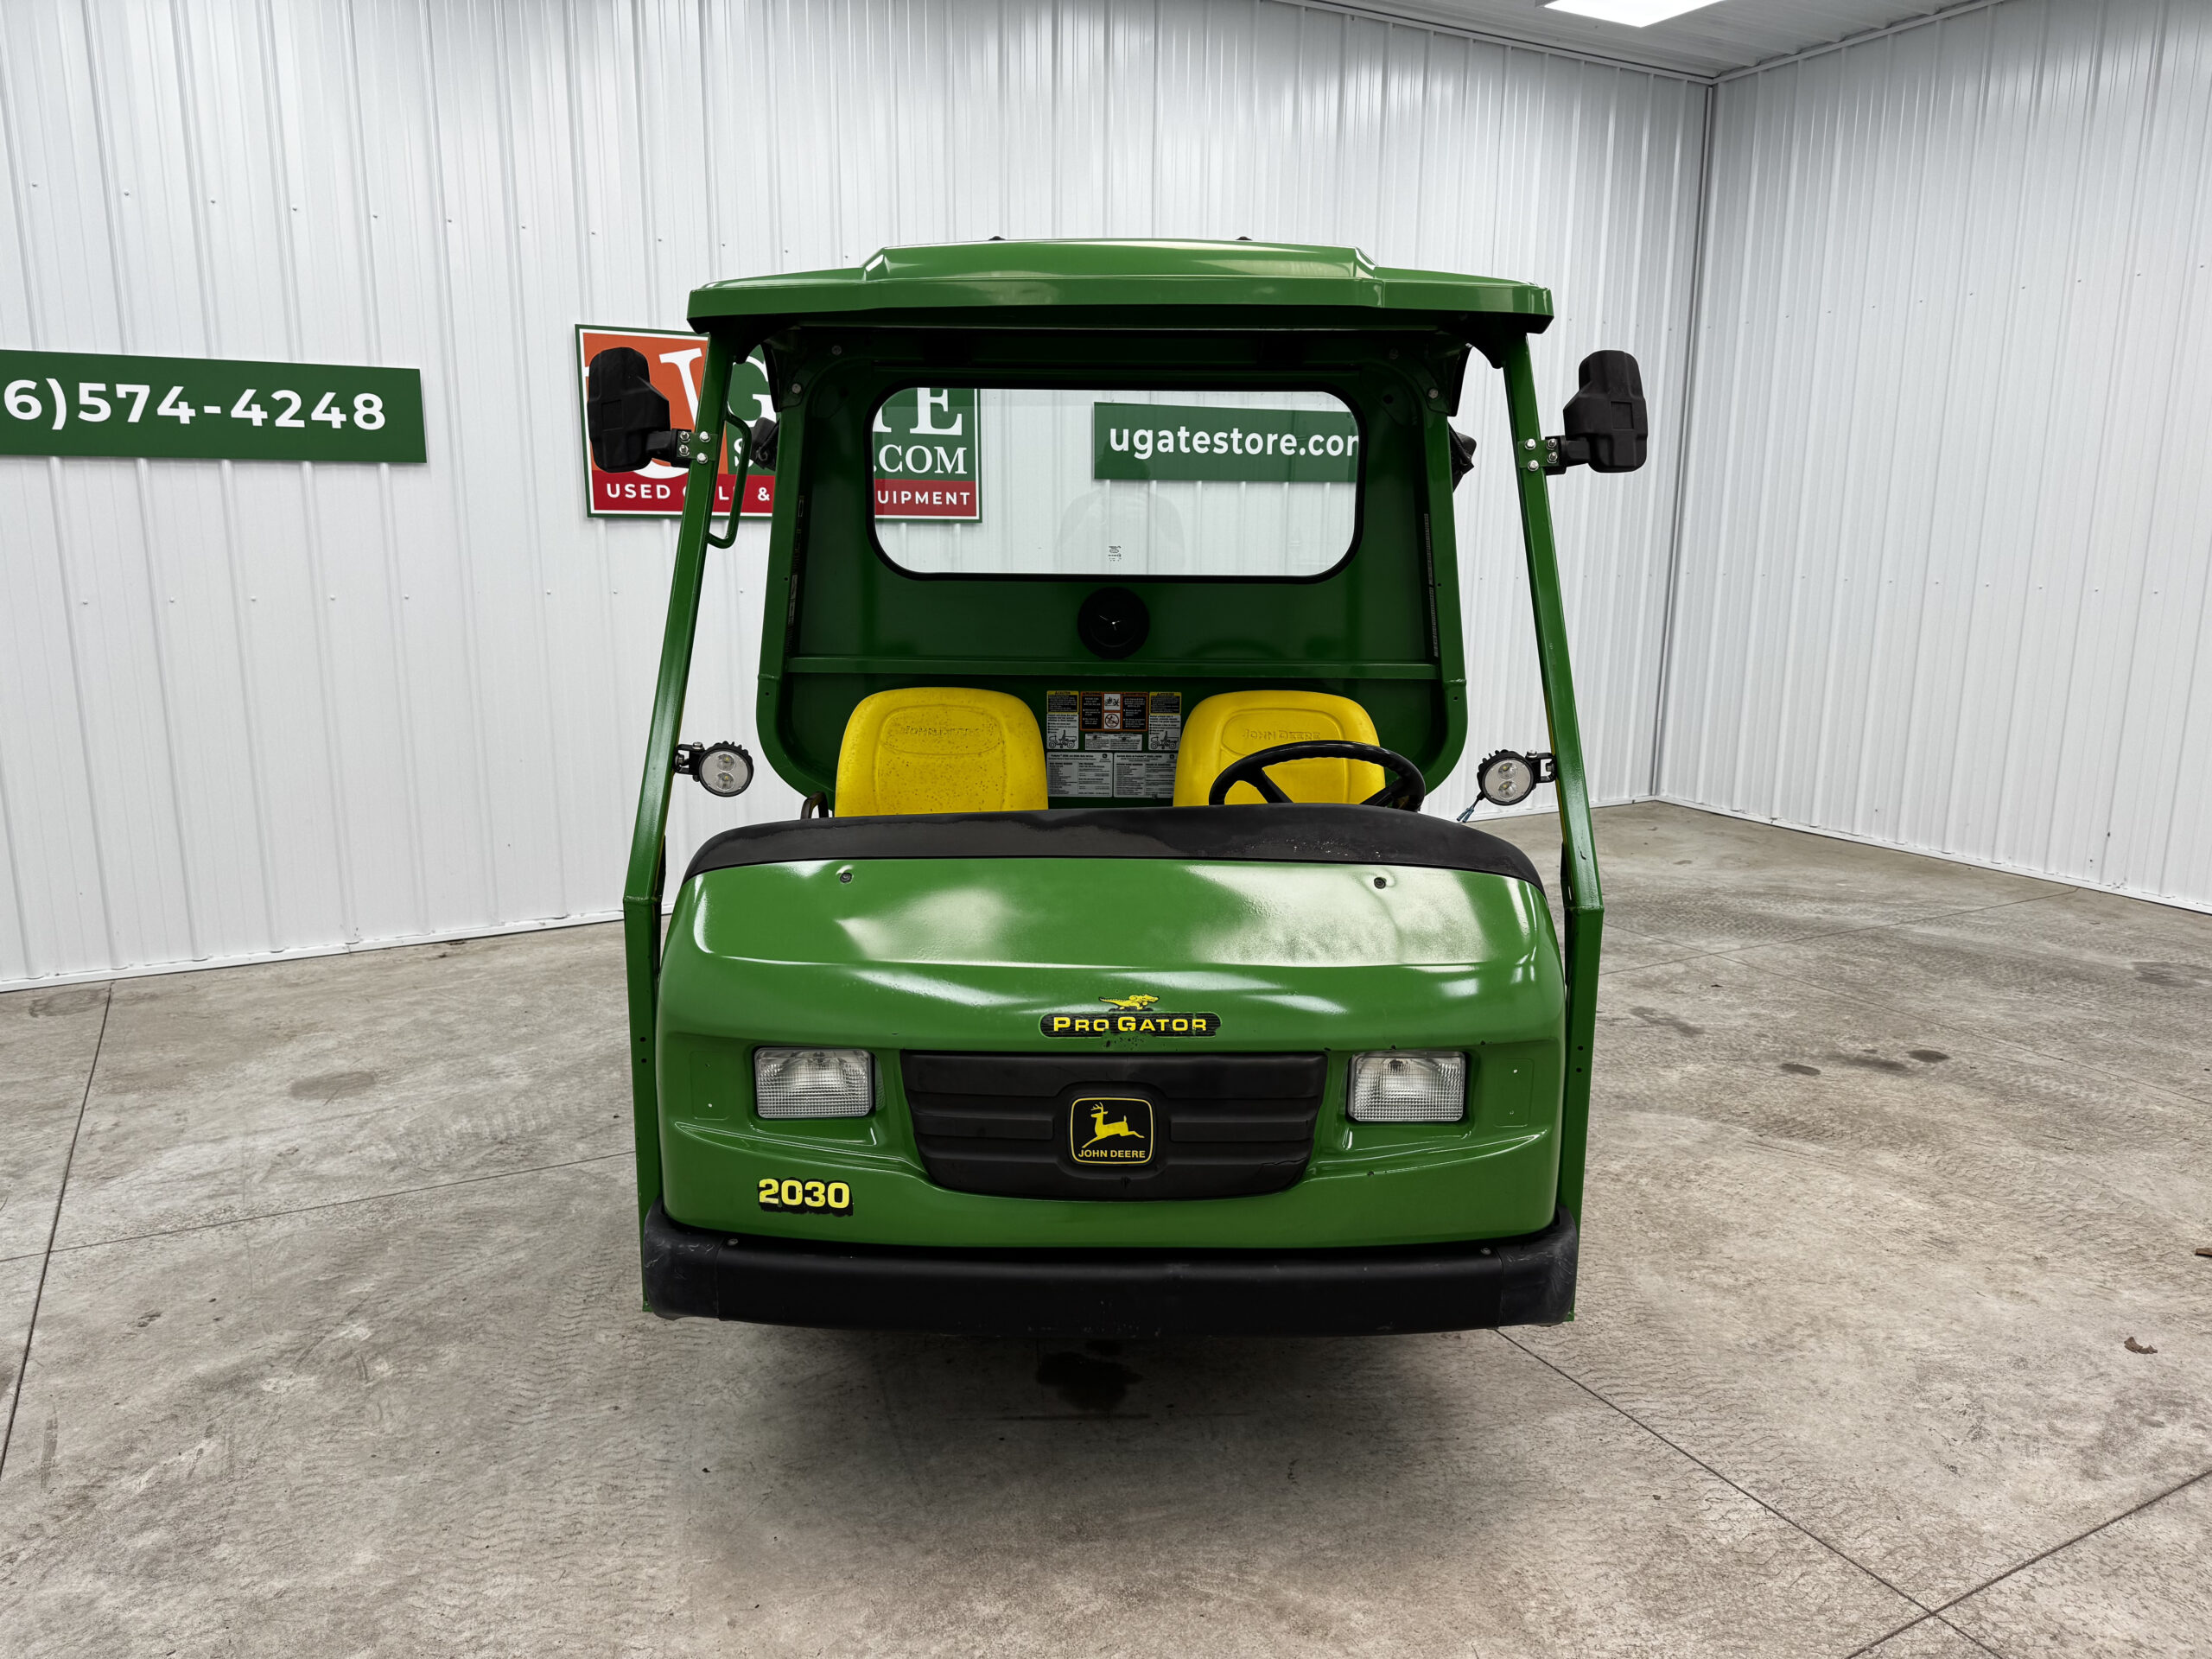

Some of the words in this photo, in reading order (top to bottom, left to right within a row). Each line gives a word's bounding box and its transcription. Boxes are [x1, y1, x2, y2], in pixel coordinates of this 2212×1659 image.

[607, 483, 671, 499] USED
[877, 490, 970, 505] UIPMENT
[1243, 728, 1276, 741] JOHN
[1278, 730, 1321, 741] DEERE
[1053, 1016, 1110, 1032] PRO
[1117, 1016, 1207, 1032] GATOR
[1077, 1149, 1108, 1158] JOHN
[1110, 1150, 1146, 1159] DEERE
[758, 1178, 851, 1210] 2030
